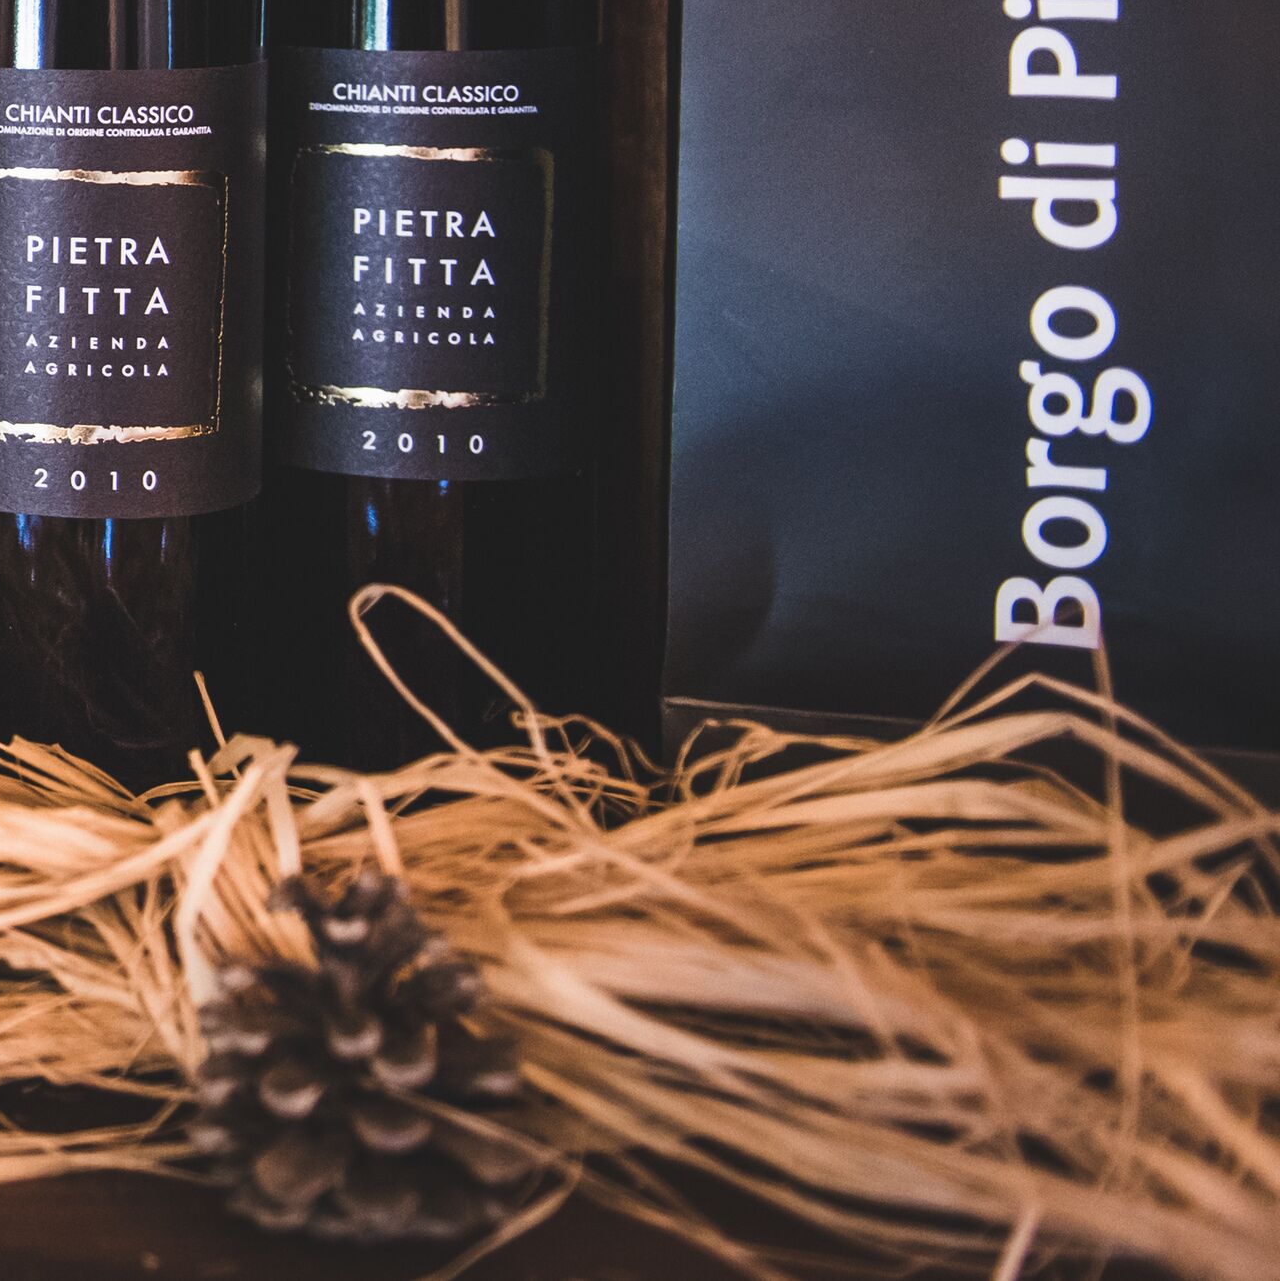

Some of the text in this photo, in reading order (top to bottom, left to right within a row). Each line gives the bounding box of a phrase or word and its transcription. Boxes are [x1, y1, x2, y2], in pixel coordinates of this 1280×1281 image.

[332, 83, 519, 103] CHIANTI CLASSICO
[5, 103, 193, 124] CHIANTI CLASSICO
[56, 128, 65, 136] DI
[67, 128, 104, 137] ORIGINE
[106, 128, 165, 137] CONTROLLATA
[166, 128, 171, 136] E
[172, 126, 212, 135] GARANTITA
[999, 137, 1118, 249] di
[353, 208, 496, 238] PIETRA
[27, 236, 170, 266] PIETRA
[353, 255, 496, 285] FITTA
[27, 285, 169, 315] FITTA
[354, 302, 495, 319] AZIENDA
[25, 334, 169, 351] AZIENDA
[352, 328, 495, 345] AGRICOLA
[24, 359, 169, 377] AGRICOLA
[362, 430, 484, 454] 2010
[995, 284, 1153, 649] Borgo
[34, 468, 158, 491] 2010
